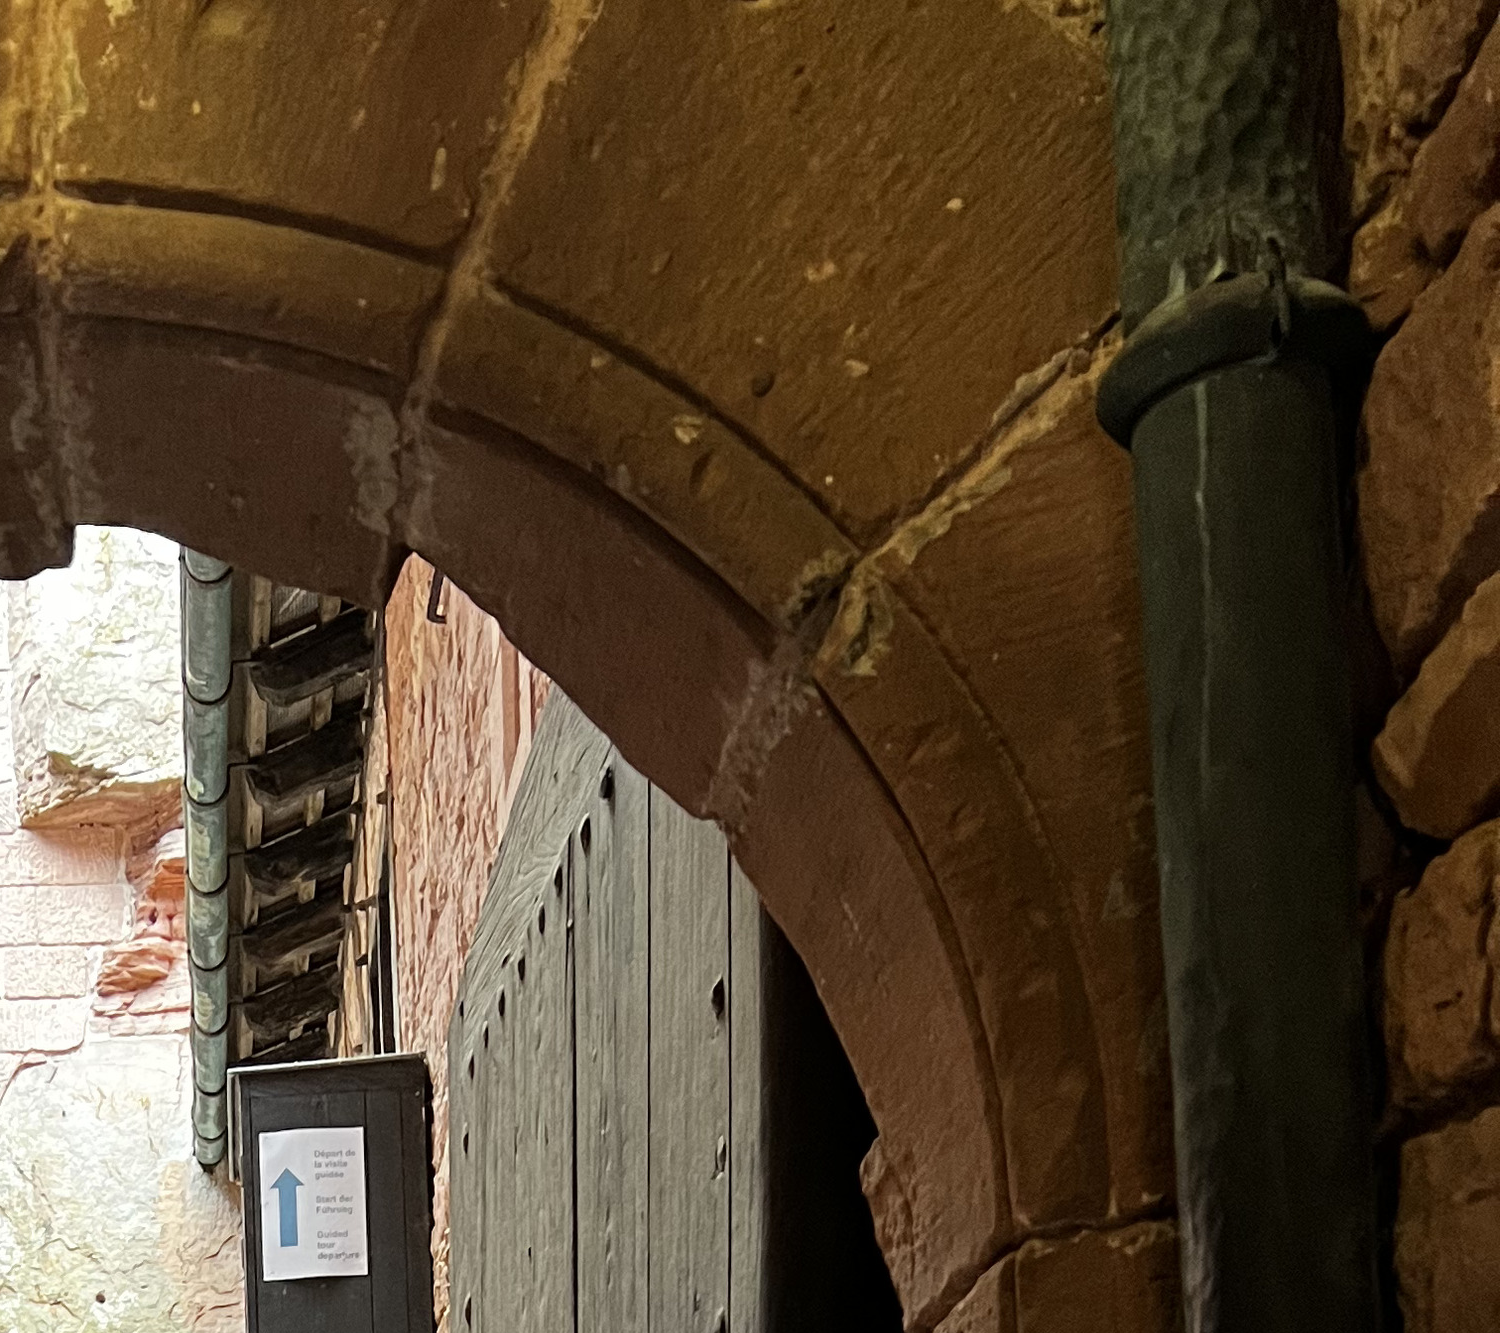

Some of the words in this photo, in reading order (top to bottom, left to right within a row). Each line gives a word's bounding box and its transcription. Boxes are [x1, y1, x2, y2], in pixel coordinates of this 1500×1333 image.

[314, 1160, 322, 1168] la
[325, 1160, 348, 1168] visite
[339, 1194, 353, 1203] der
[317, 1230, 348, 1238] Guided
[317, 1252, 360, 1261] departure
